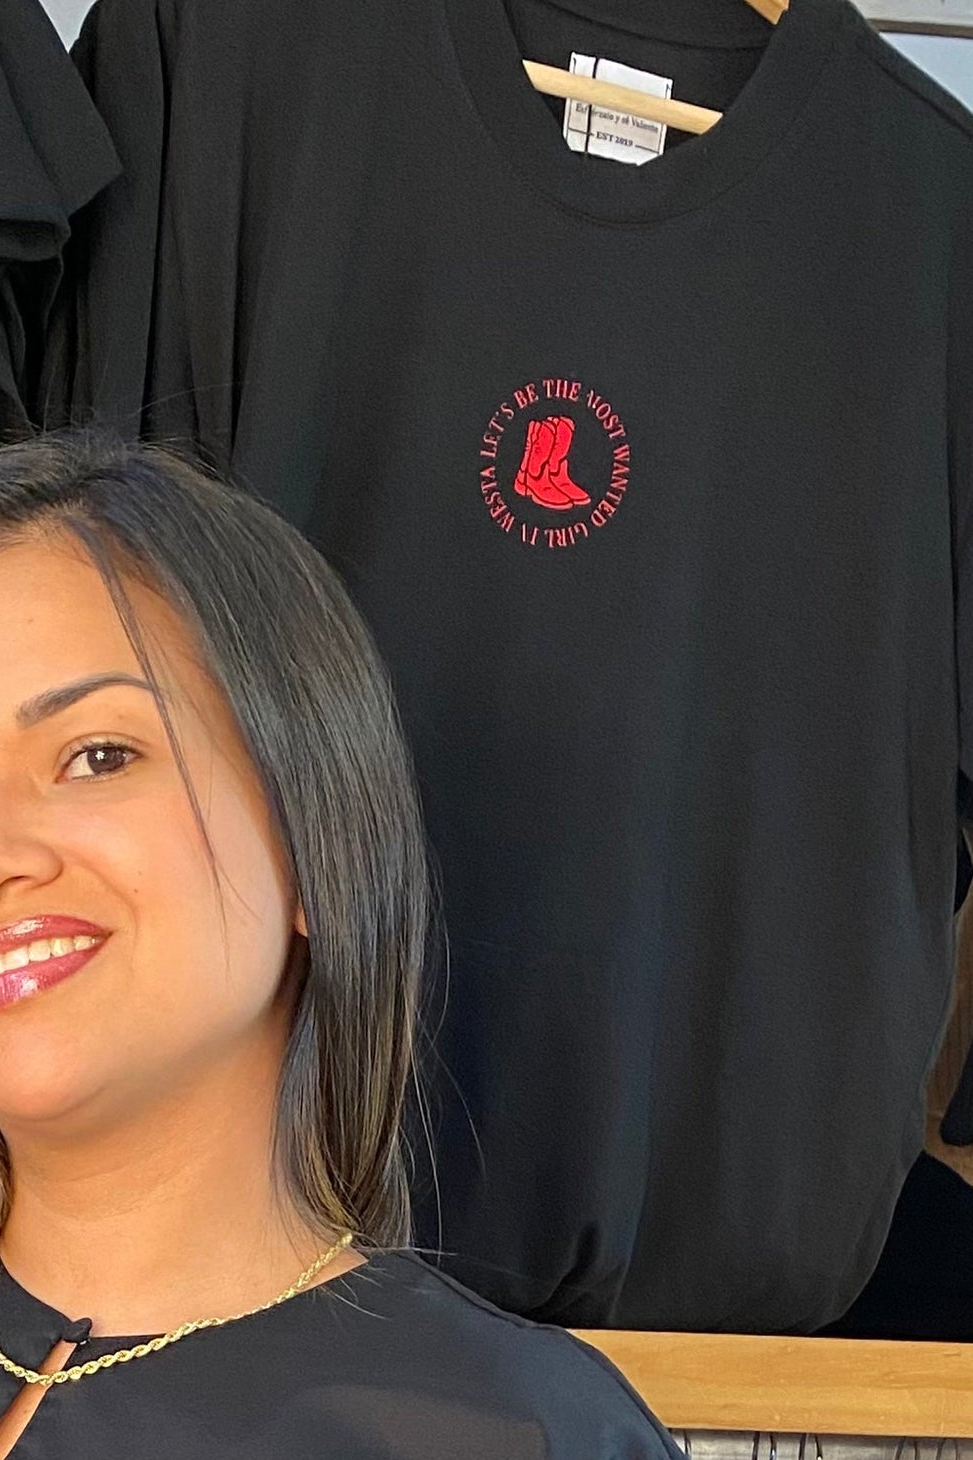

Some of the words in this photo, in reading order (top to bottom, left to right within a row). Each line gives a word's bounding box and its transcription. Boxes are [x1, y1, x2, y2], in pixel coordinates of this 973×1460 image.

[596, 131, 614, 142] EST
[615, 135, 633, 147] 2019
[513, 383, 539, 409] BE
[543, 379, 581, 402] THE
[586, 390, 626, 439] MOST
[480, 403, 515, 458] LET'S
[591, 444, 630, 527] WANTED
[544, 522, 588, 548] GIRL
